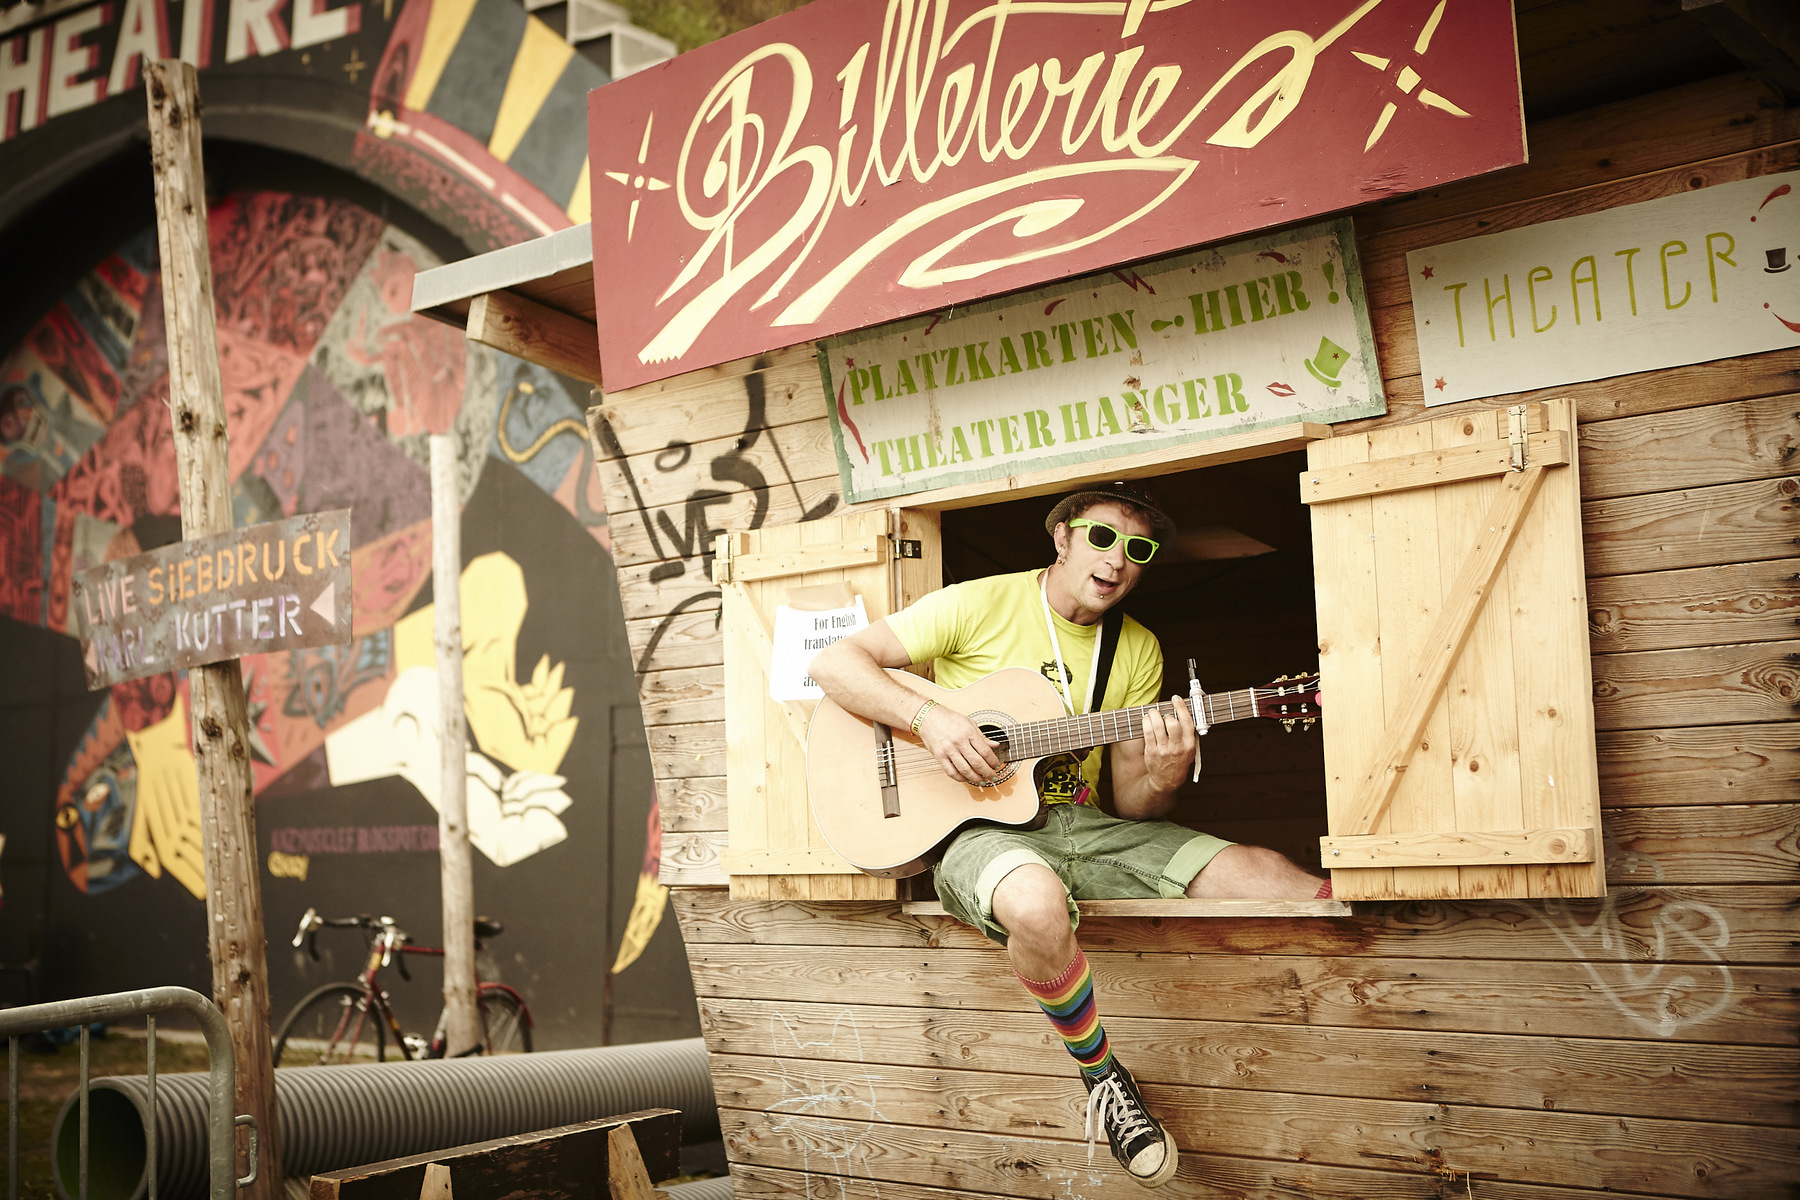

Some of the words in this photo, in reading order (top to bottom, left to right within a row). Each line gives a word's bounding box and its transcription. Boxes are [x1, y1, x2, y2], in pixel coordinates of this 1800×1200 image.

[1443, 230, 1739, 349] THEATER
[850, 310, 1139, 406] PLATZKARTEN
[1187, 270, 1312, 336] HIER
[871, 407, 1057, 477] THEATER
[175, 593, 304, 652] KUTTER
[804, 634, 848, 650] translat
[814, 618, 829, 631] For
[831, 613, 856, 629] English
